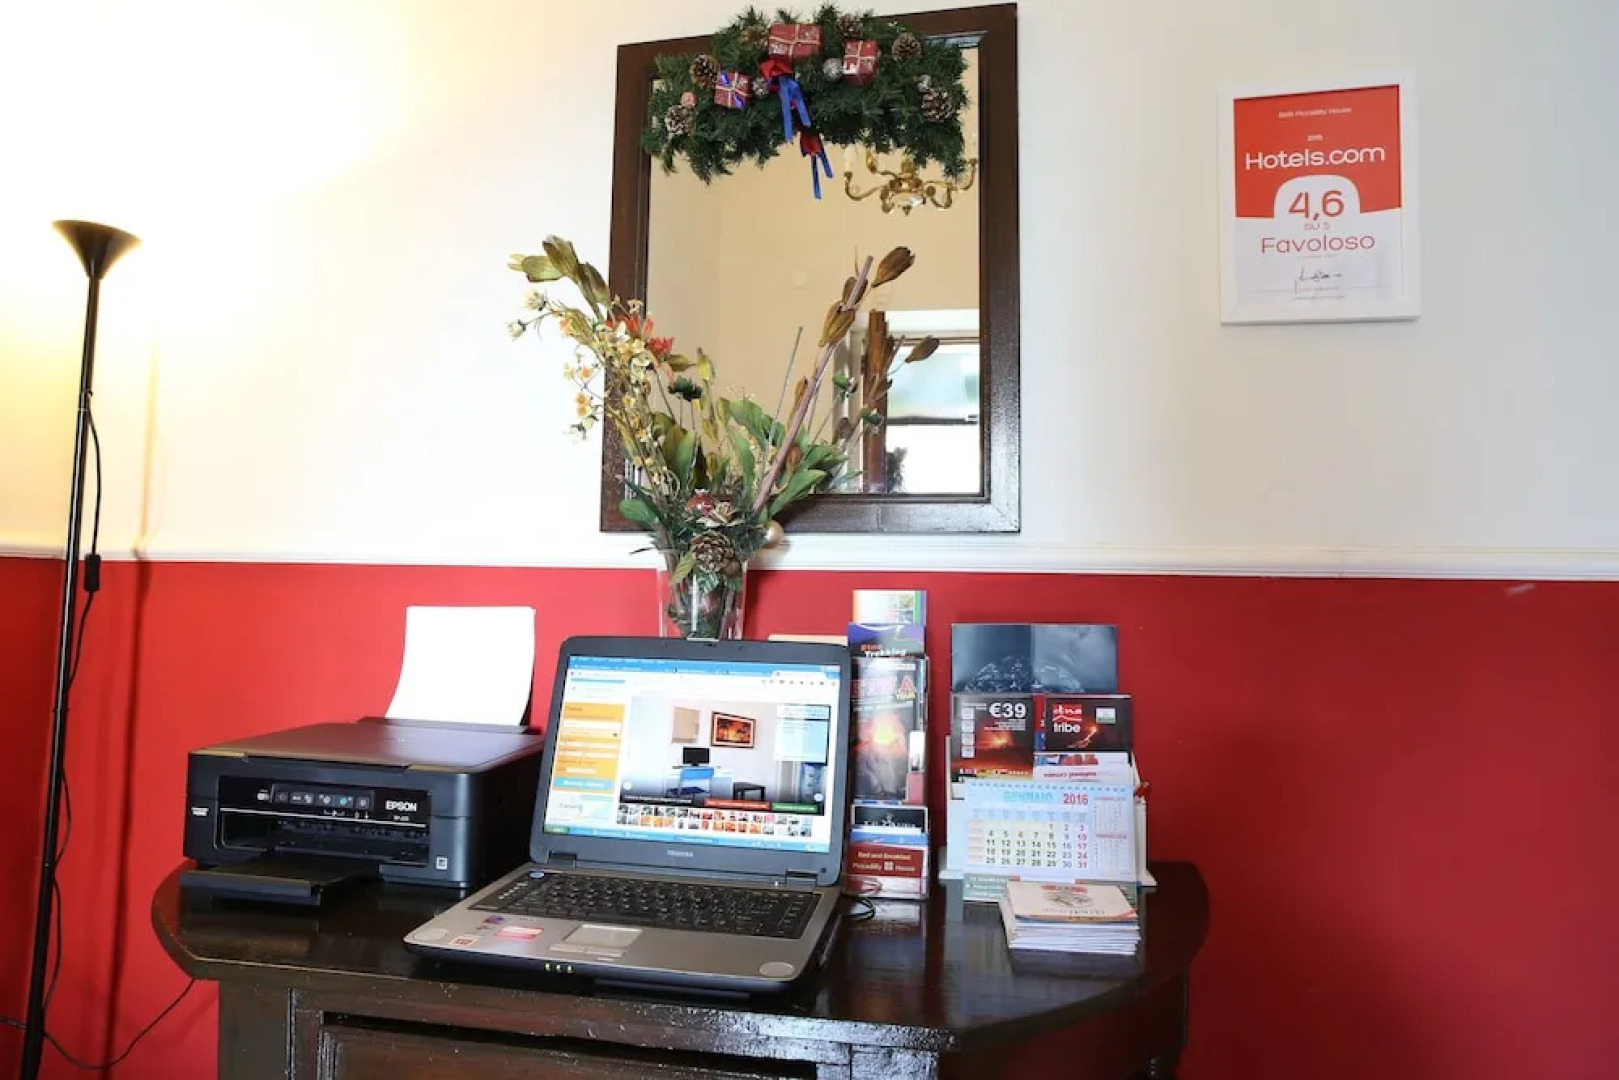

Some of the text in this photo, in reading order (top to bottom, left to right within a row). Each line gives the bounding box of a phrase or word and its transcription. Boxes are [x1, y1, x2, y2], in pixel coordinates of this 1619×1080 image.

[1245, 146, 1386, 170] Hotels.com
[1289, 190, 1344, 220] 4,6
[1261, 235, 1376, 254] Favoloso
[988, 702, 1026, 718] €39
[1052, 722, 1080, 732] tribe
[386, 800, 416, 812] EPSON
[1063, 793, 1088, 804] 2016
